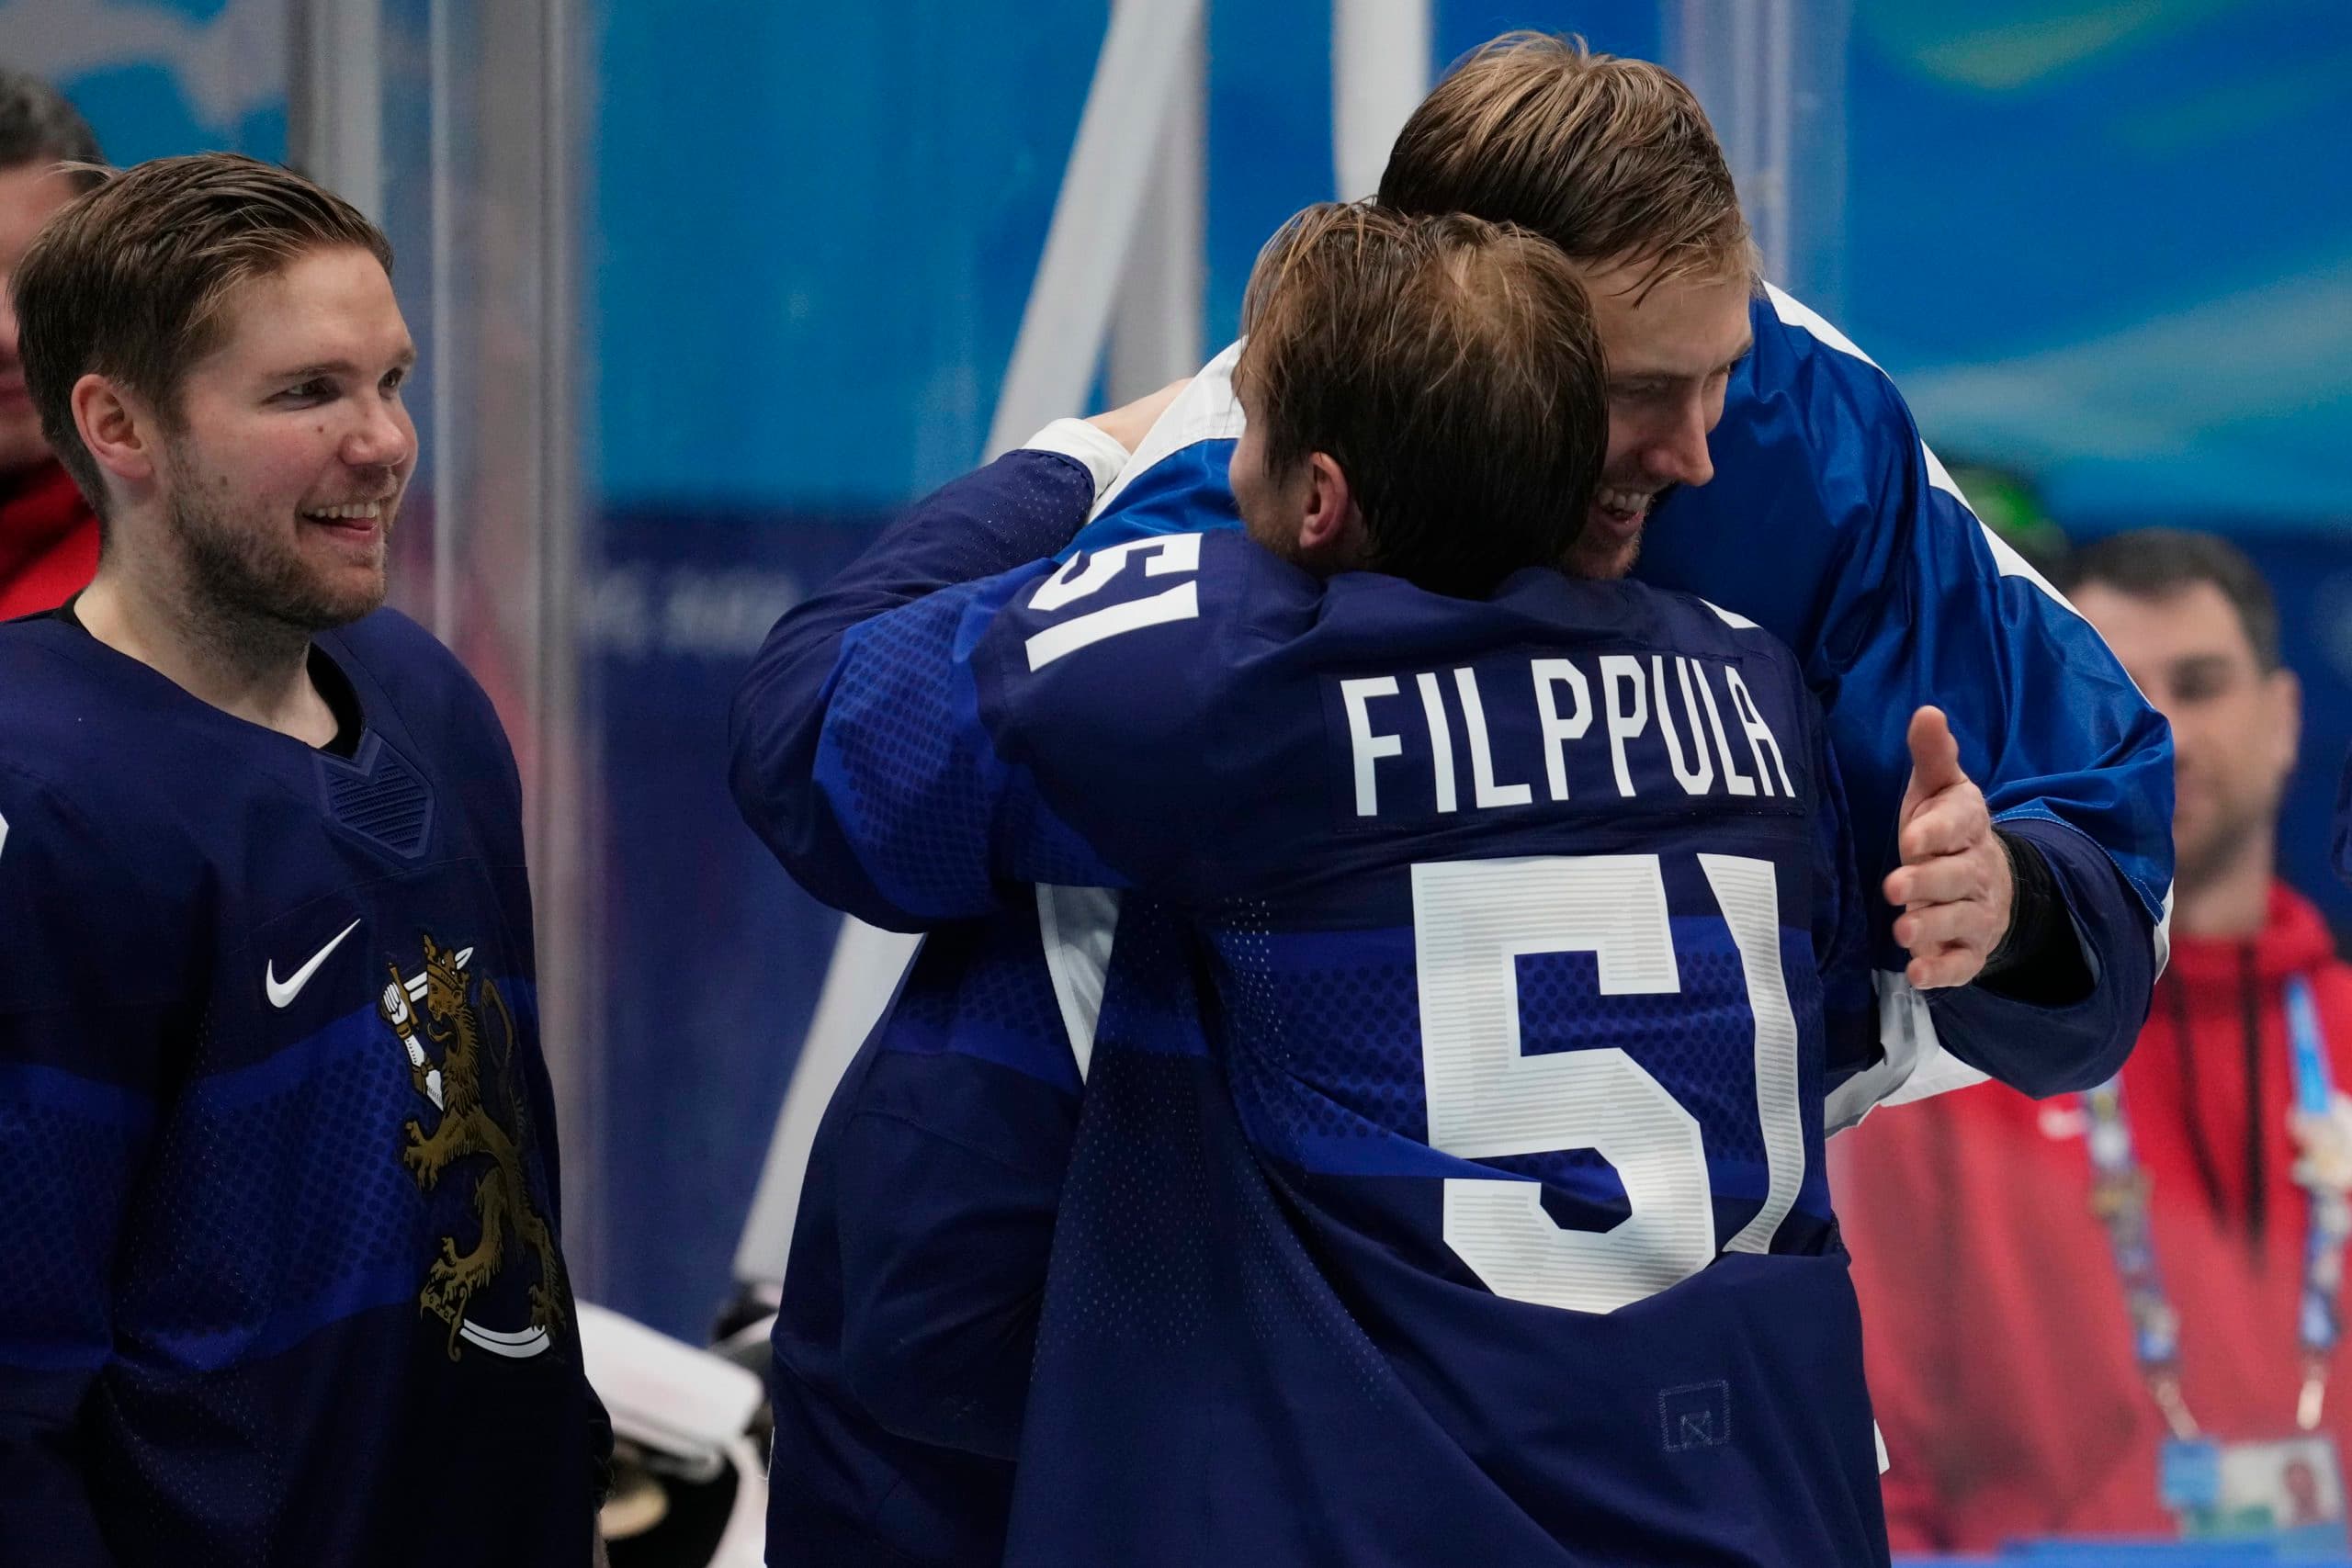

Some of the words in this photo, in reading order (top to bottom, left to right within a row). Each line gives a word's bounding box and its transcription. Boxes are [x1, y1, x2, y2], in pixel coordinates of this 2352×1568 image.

[1024, 532, 1204, 673] 51
[1340, 655, 1796, 817] FILPPULA
[1410, 852, 1805, 1315] 51
